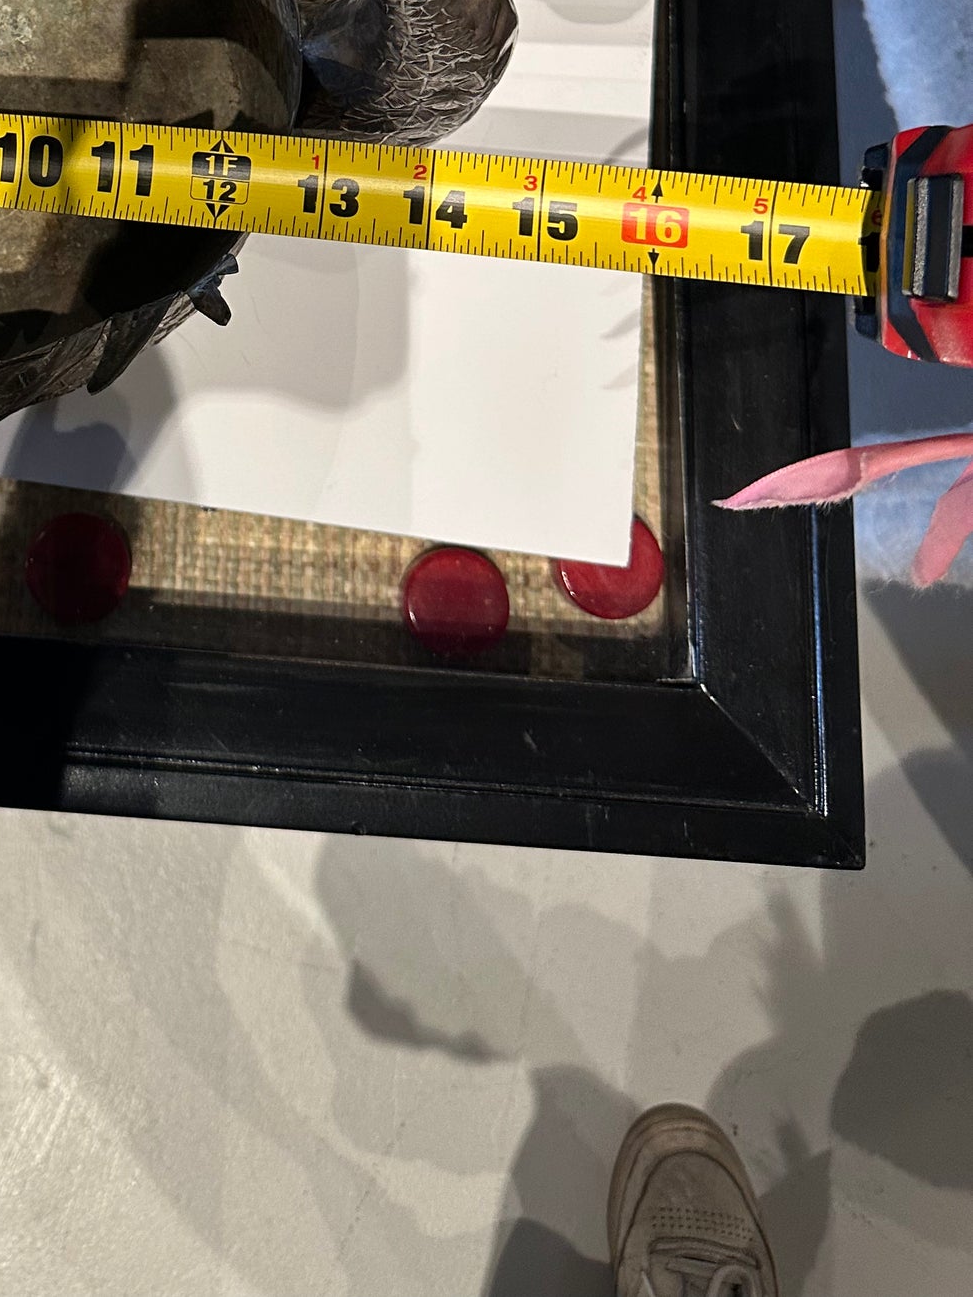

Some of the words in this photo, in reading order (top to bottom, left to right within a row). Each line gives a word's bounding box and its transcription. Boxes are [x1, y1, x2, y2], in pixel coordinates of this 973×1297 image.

[90, 139, 154, 198] 11
[204, 154, 238, 177] 1F
[311, 154, 321, 171] 1
[413, 164, 427, 181] 2
[201, 179, 238, 203] 12
[523, 175, 538, 192] 3
[631, 185, 647, 202] 4
[297, 174, 360, 219] 13
[403, 182, 467, 230] 14
[754, 197, 769, 214] 5
[512, 196, 578, 241] 15
[628, 206, 683, 244] 16
[741, 220, 810, 265] 17
